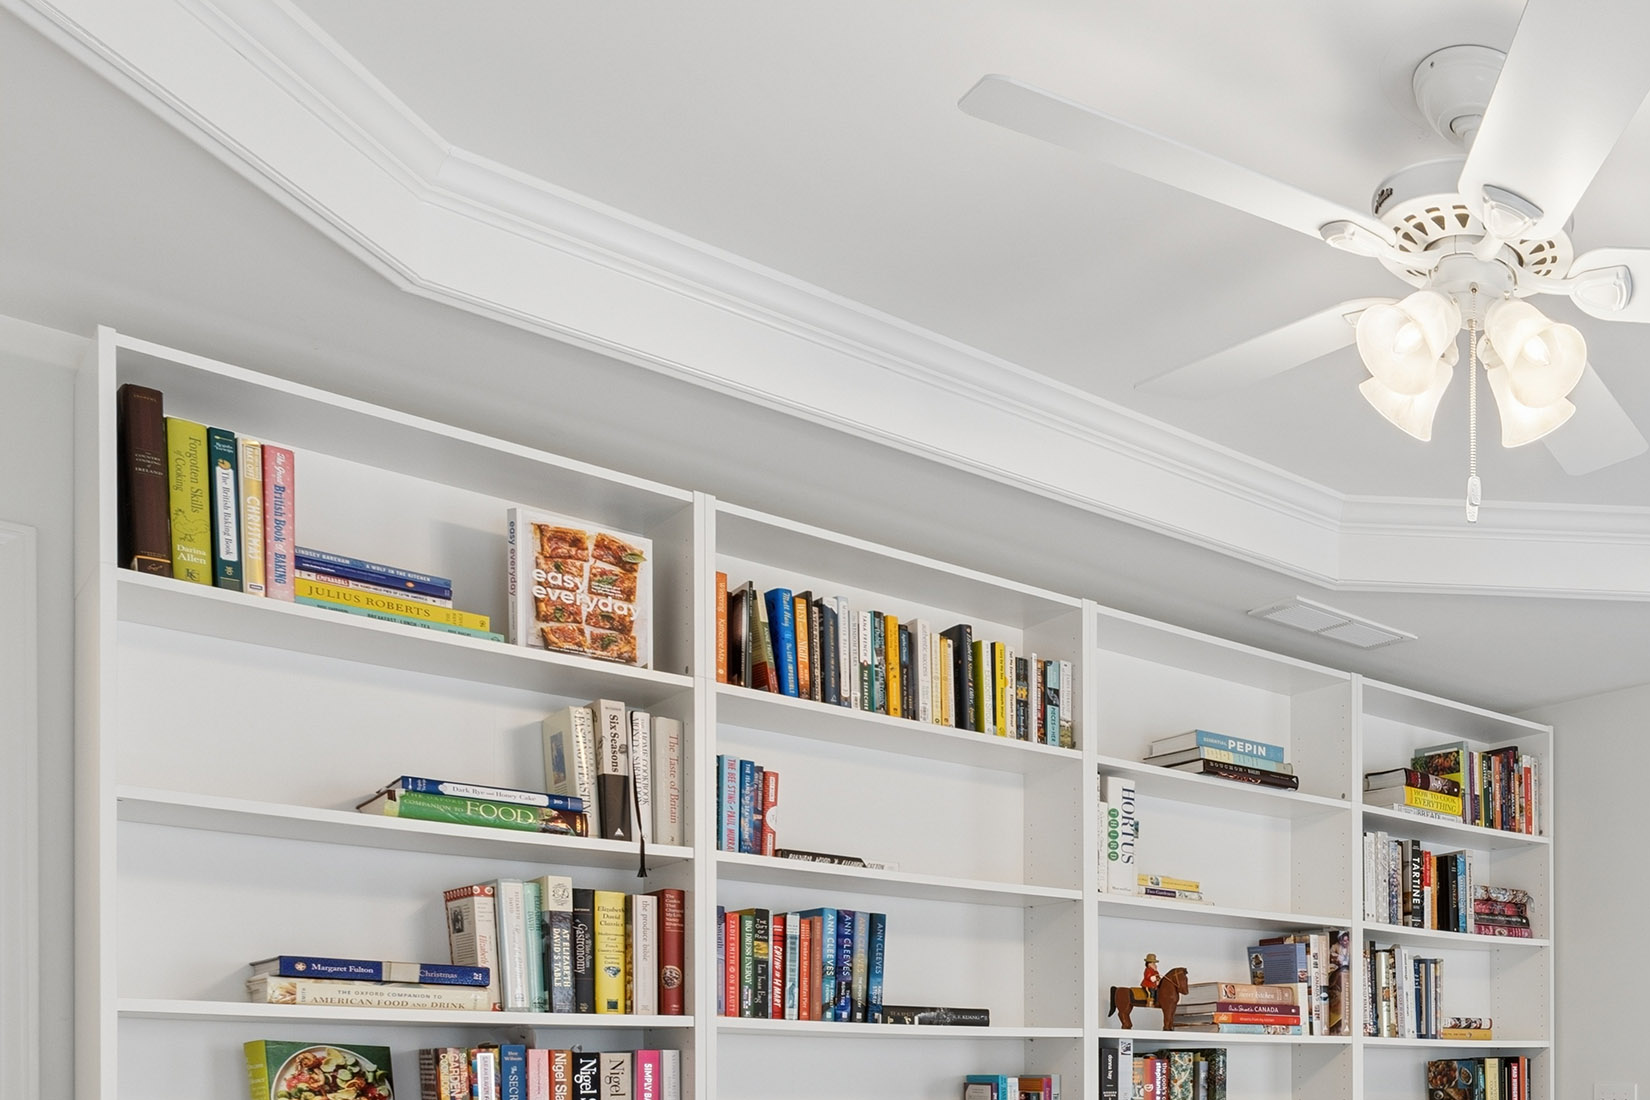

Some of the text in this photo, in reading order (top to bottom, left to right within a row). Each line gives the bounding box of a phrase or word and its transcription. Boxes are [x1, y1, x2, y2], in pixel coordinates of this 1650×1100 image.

[185, 436, 203, 514] Forgotten Skills
[176, 544, 207, 556] Darina
[273, 484, 287, 585] British Book BAKING
[176, 553, 207, 565] Allen
[508, 521, 517, 597] easy everyday
[532, 568, 587, 595] easy
[307, 585, 431, 617] JULIUS ROBERTS
[532, 584, 639, 621] everyday
[609, 713, 619, 773] Six Seasons
[1228, 739, 1267, 757] PEPIN
[404, 798, 535, 824] COMPANION FOOD
[669, 793, 680, 824] Britain
[726, 758, 737, 831] THE BEE STING PAUL
[1413, 789, 1457, 804] HOW TO COOK
[1414, 797, 1457, 813] EVERYTHING
[1109, 809, 1118, 860] THIRD
[1120, 787, 1136, 865] HORTUS
[1412, 857, 1421, 904] TARTINE
[743, 933, 753, 985] DRESS ENERGY
[825, 913, 835, 976] ANN CLEEVES
[842, 914, 852, 976] ANN CLEEVES
[856, 917, 867, 973] ANN CLEEVES
[875, 922, 885, 975] ANN CLEEVES
[311, 963, 374, 976] Margaret Fulton
[419, 968, 458, 979] Christmas
[553, 964, 562, 988] TABLE
[561, 939, 572, 989] ELIZABETH
[311, 996, 465, 1010] AMERICAN FOOD DRINK
[387, 991, 431, 999] COMPANION
[728, 986, 736, 1012] BEAUTY
[551, 1053, 568, 1083] Nigel
[574, 1058, 598, 1095] Nigel
[604, 1058, 626, 1097] Nigel
[643, 1063, 653, 1091] SIMPLY
[1154, 1061, 1162, 1098] stephanie
